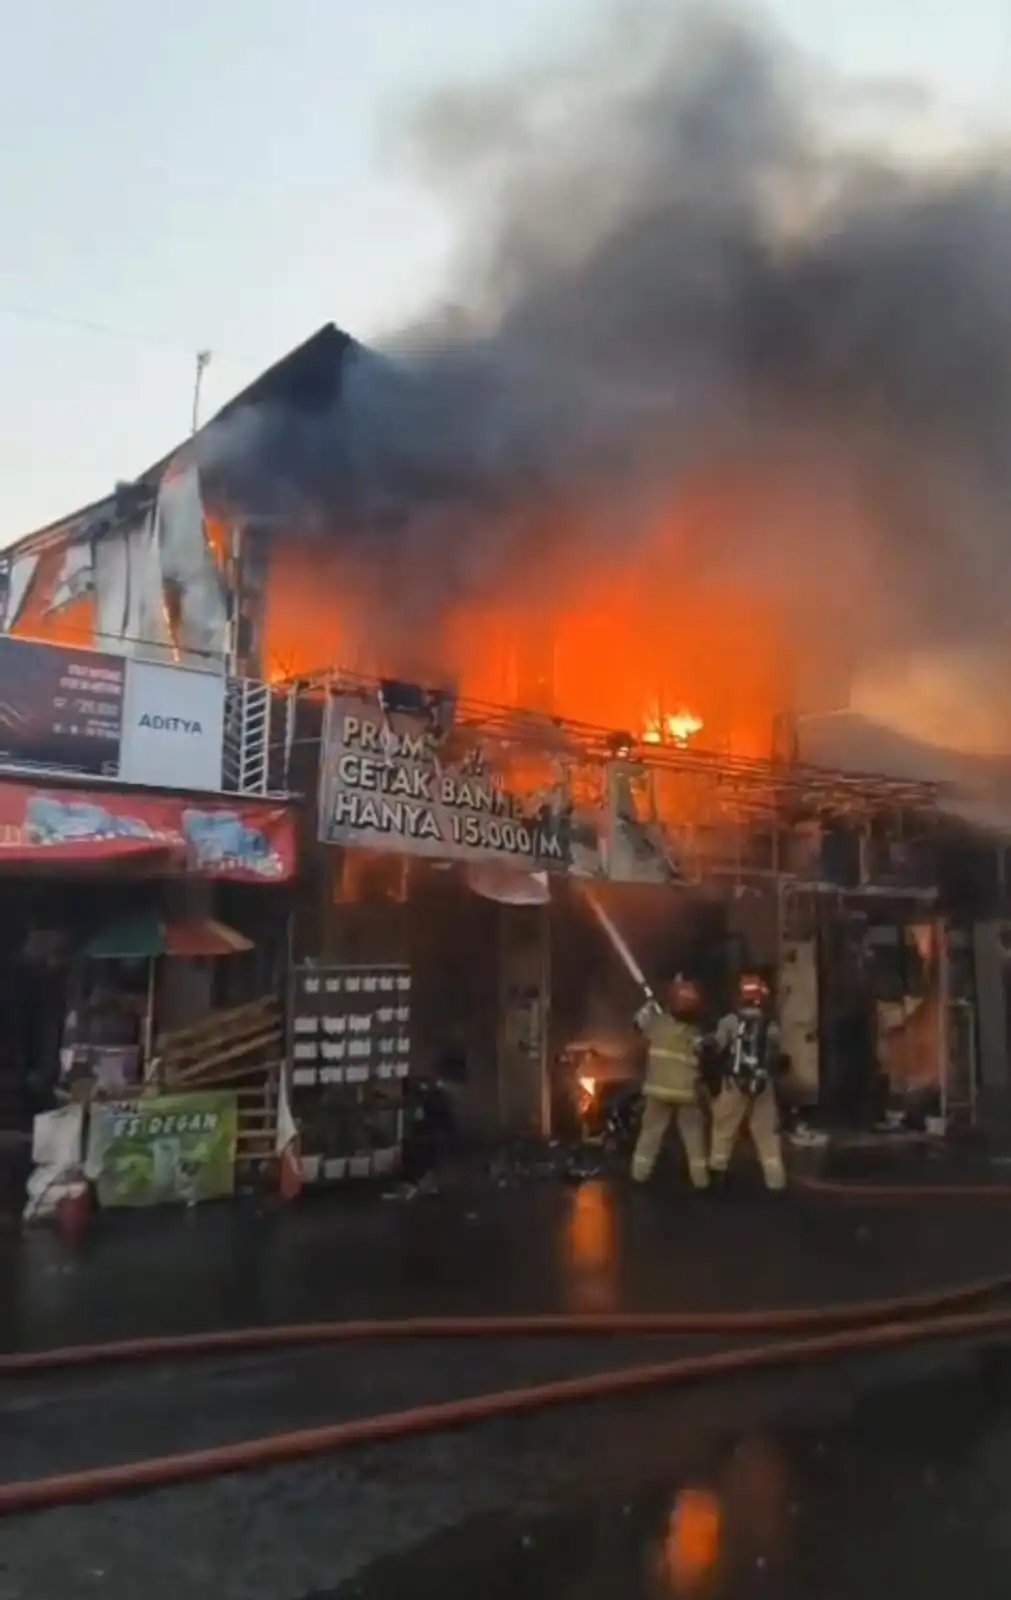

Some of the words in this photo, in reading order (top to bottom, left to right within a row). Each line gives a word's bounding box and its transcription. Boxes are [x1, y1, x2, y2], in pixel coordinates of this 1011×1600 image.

[138, 713, 202, 735] ADITYA
[338, 755, 432, 799] CETAK
[335, 793, 441, 840] HANYA
